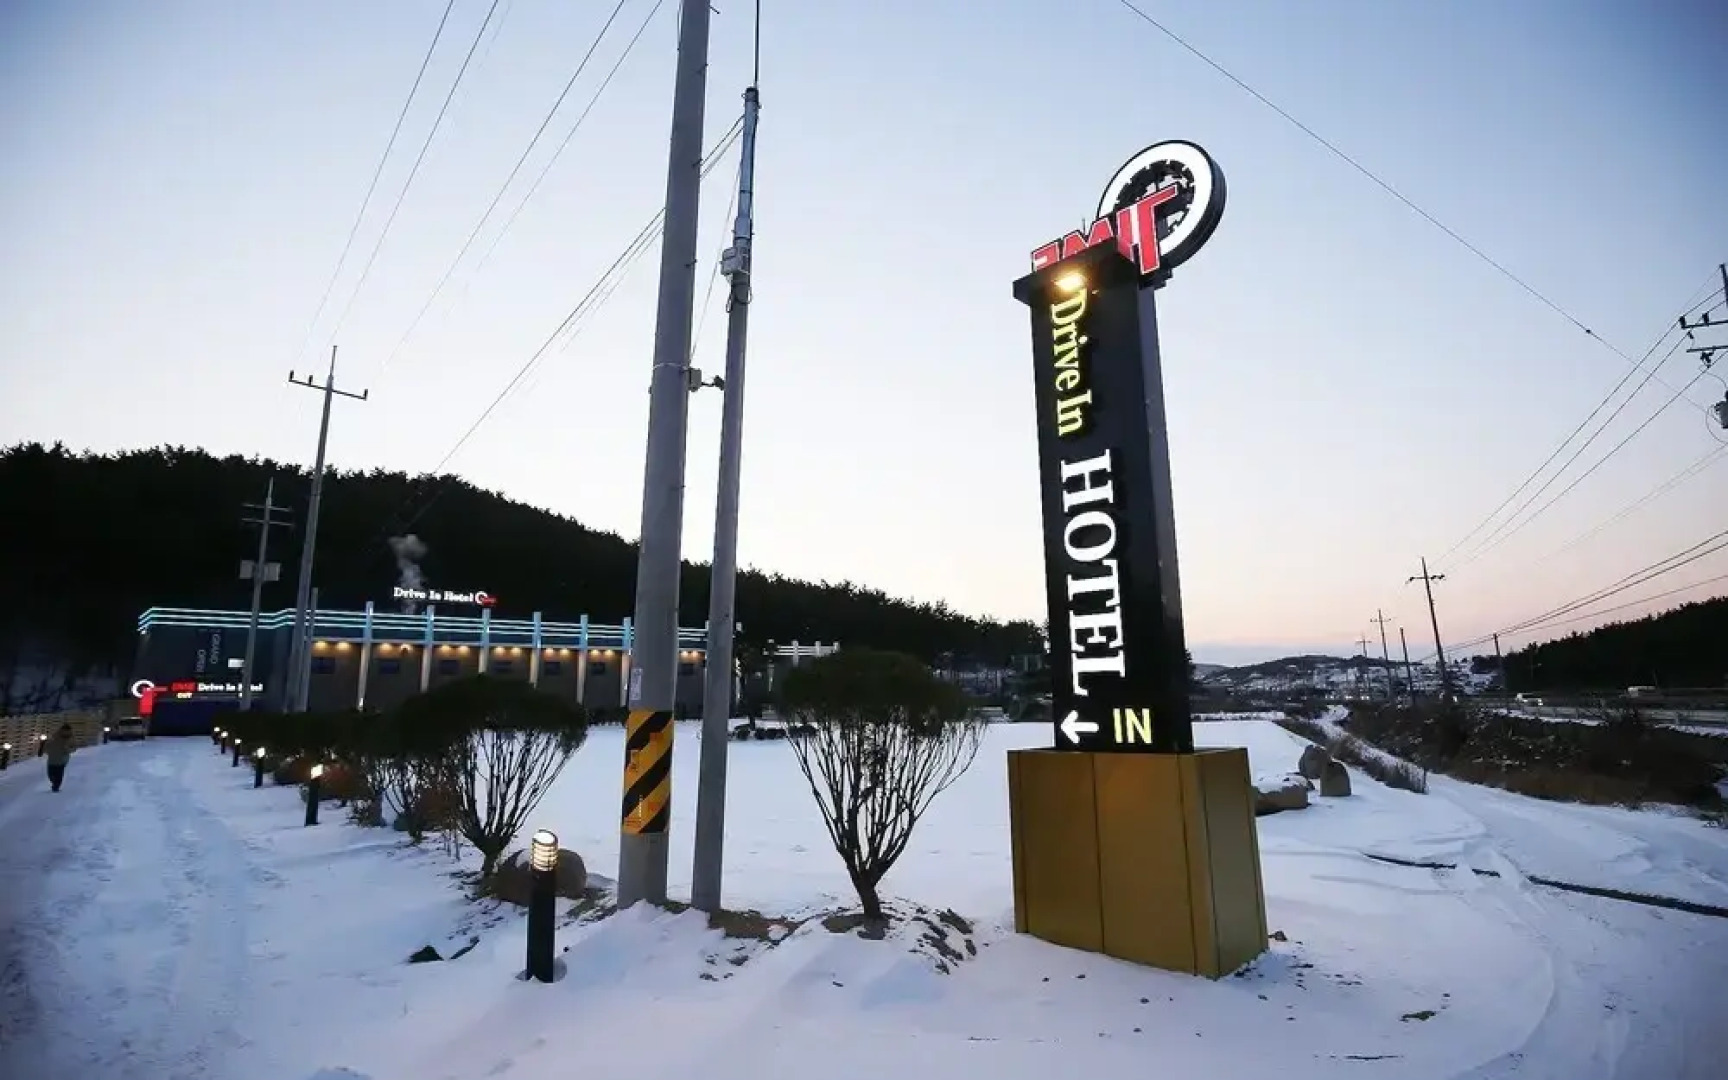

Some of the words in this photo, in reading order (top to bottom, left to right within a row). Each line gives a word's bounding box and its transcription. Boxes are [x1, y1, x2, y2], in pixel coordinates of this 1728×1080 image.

[1050, 287, 1088, 391] Drive
[1057, 389, 1093, 435] In
[1060, 448, 1126, 697] HOTEL
[393, 586, 426, 599] Drive
[429, 590, 442, 601] In
[444, 591, 474, 603] Hotel
[198, 682, 224, 692] Drive
[1112, 707, 1153, 744] IN
